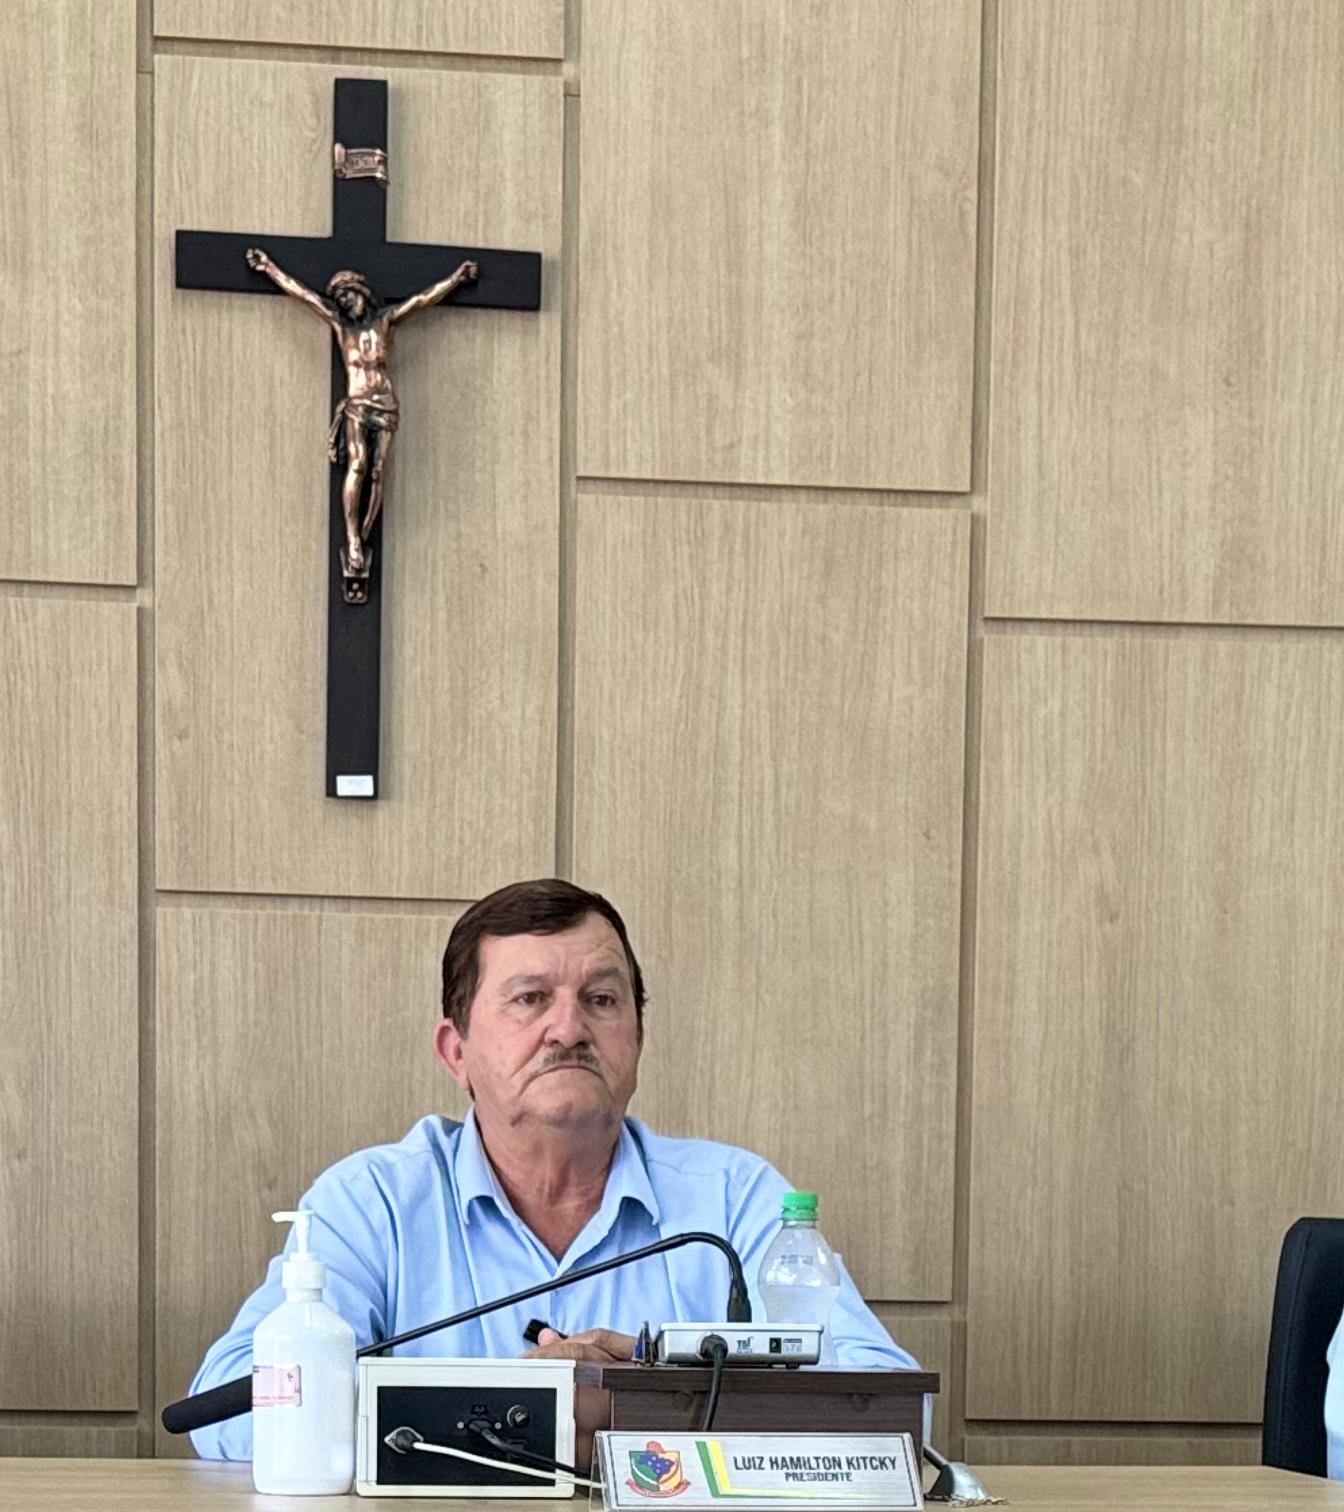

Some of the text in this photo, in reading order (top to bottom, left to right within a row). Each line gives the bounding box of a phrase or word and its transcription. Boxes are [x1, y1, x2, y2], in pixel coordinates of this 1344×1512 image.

[733, 1456, 897, 1470] LUIZ HAMILTON KITCKY
[784, 1472, 854, 1482] PRESIDENTE
